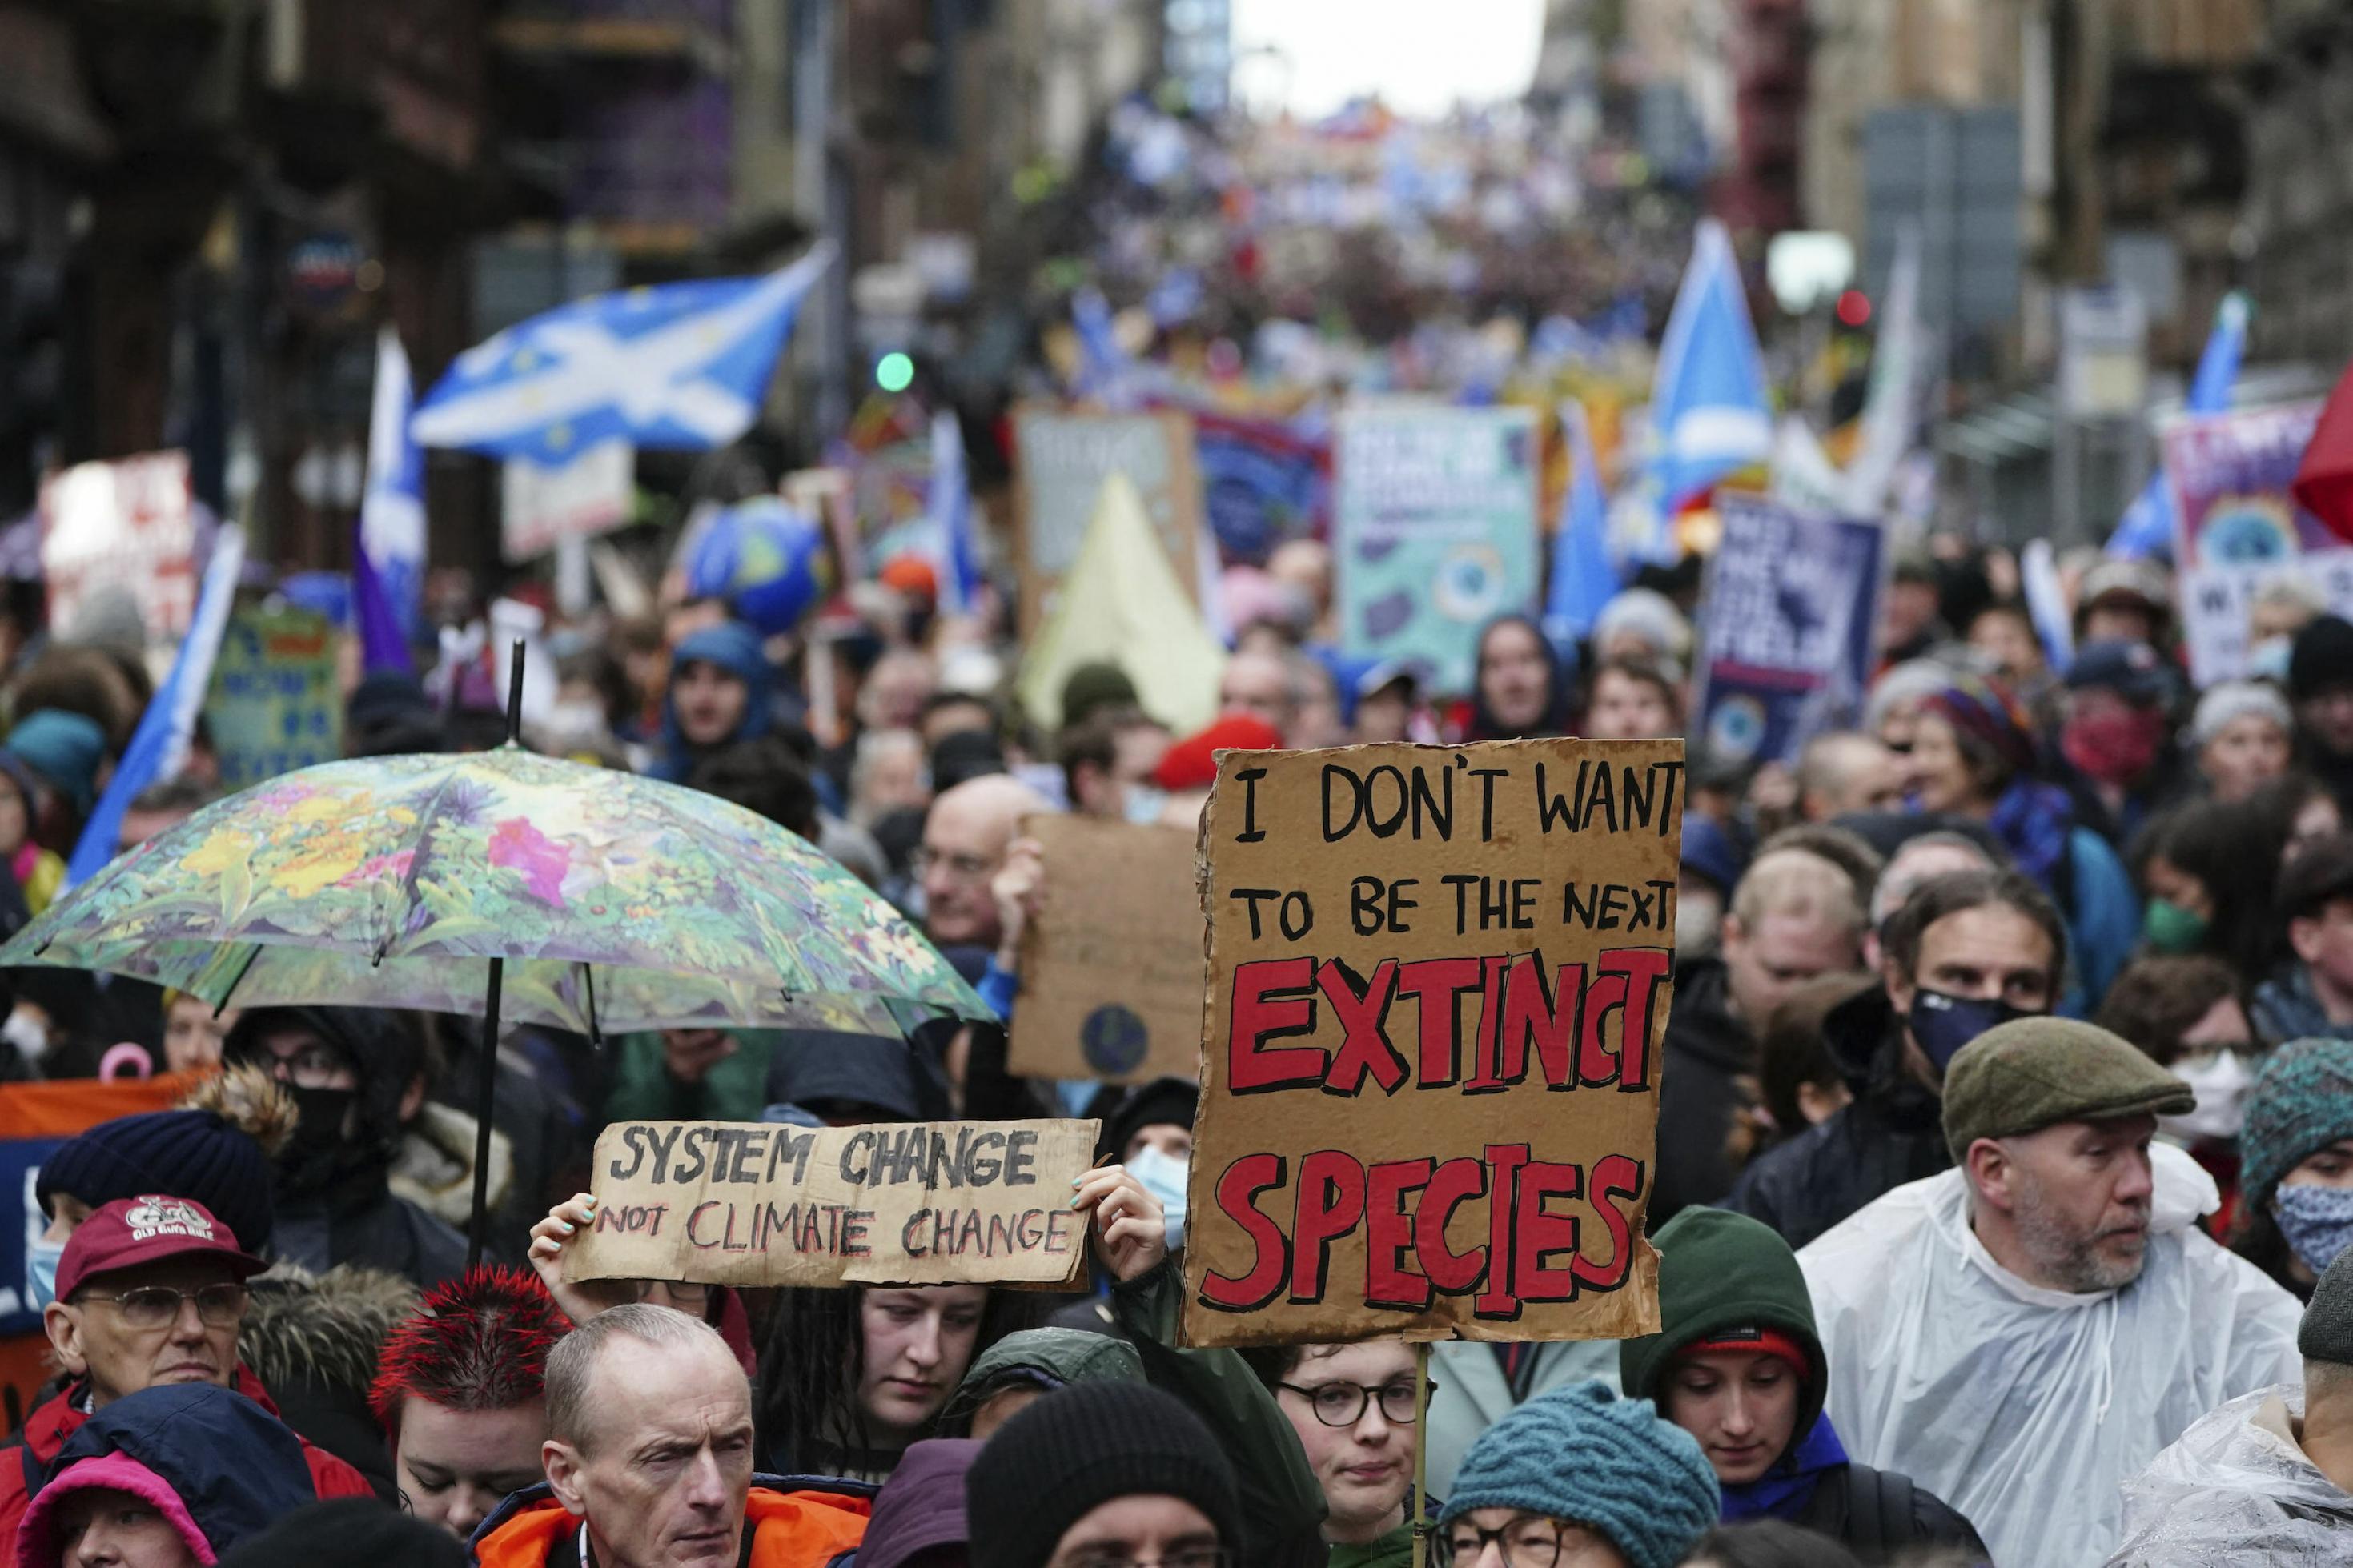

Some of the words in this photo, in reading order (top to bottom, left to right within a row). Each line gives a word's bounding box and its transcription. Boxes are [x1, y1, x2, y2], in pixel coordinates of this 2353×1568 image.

[1235, 768, 1267, 843] I
[1322, 753, 1508, 843] DON'T
[1536, 760, 1684, 837] WANT
[1230, 889, 1314, 941] TO
[1351, 876, 1418, 936] BE
[1441, 875, 1541, 935] THE
[1564, 880, 1675, 932] NEXT
[1227, 948, 1674, 1097] EXTINCT
[611, 1126, 815, 1185] SYSTEM
[840, 1128, 1038, 1190] CHANGE
[133, 1227, 156, 1241] OLD
[187, 1226, 215, 1241] RULE
[596, 1203, 669, 1237] NOT
[686, 1201, 875, 1257] CLIMATE
[901, 1208, 1072, 1257] CHANGE
[1198, 1142, 1645, 1321] SPECIES
